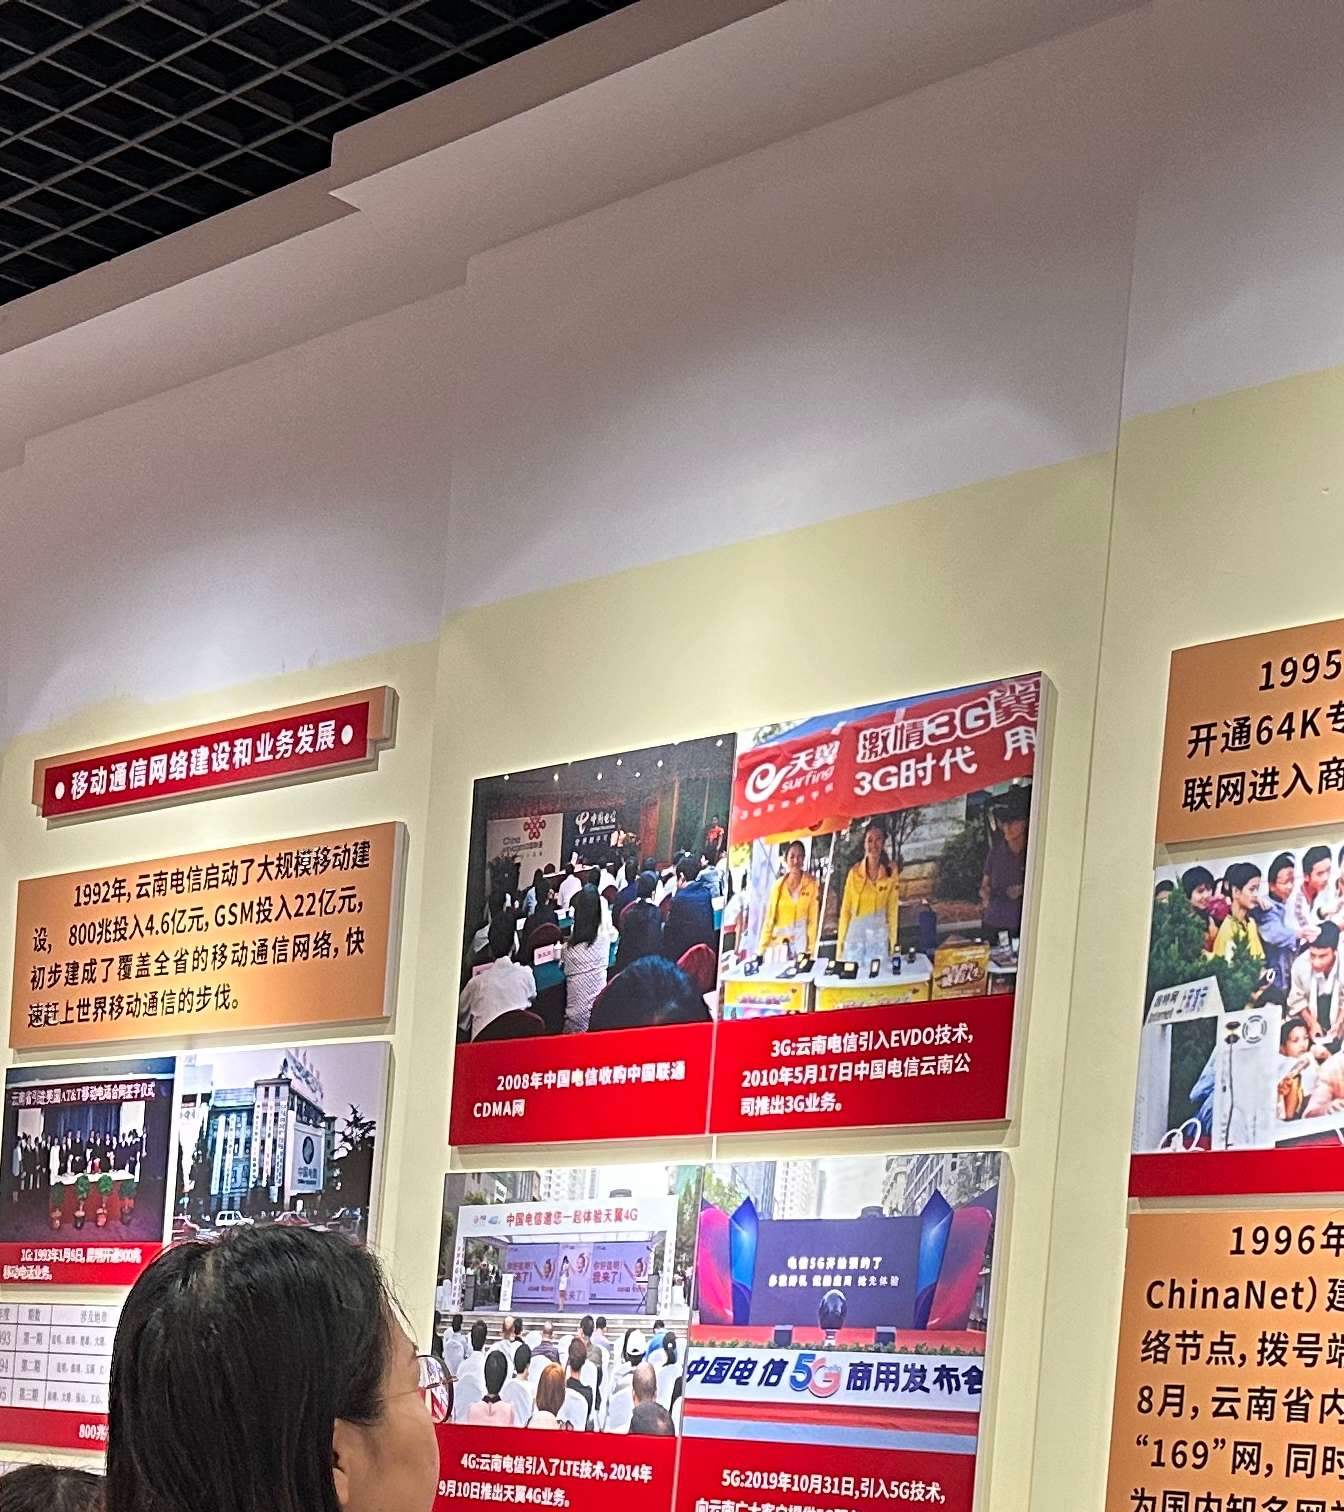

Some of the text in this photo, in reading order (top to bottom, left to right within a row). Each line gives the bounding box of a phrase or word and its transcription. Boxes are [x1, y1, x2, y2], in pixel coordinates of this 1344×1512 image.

[70, 719, 336, 801] 移动通信网络建设和业务发展
[27, 983, 240, 1029] 速赶上世界移动通信的步伐。
[496, 1060, 686, 1091] 2008年中国电信收购中国联通
[741, 1053, 972, 1089] 2010年5月17日中国电信云南公
[473, 1100, 525, 1119] CDMA网
[740, 1092, 843, 1118] 司推出3G业务。
